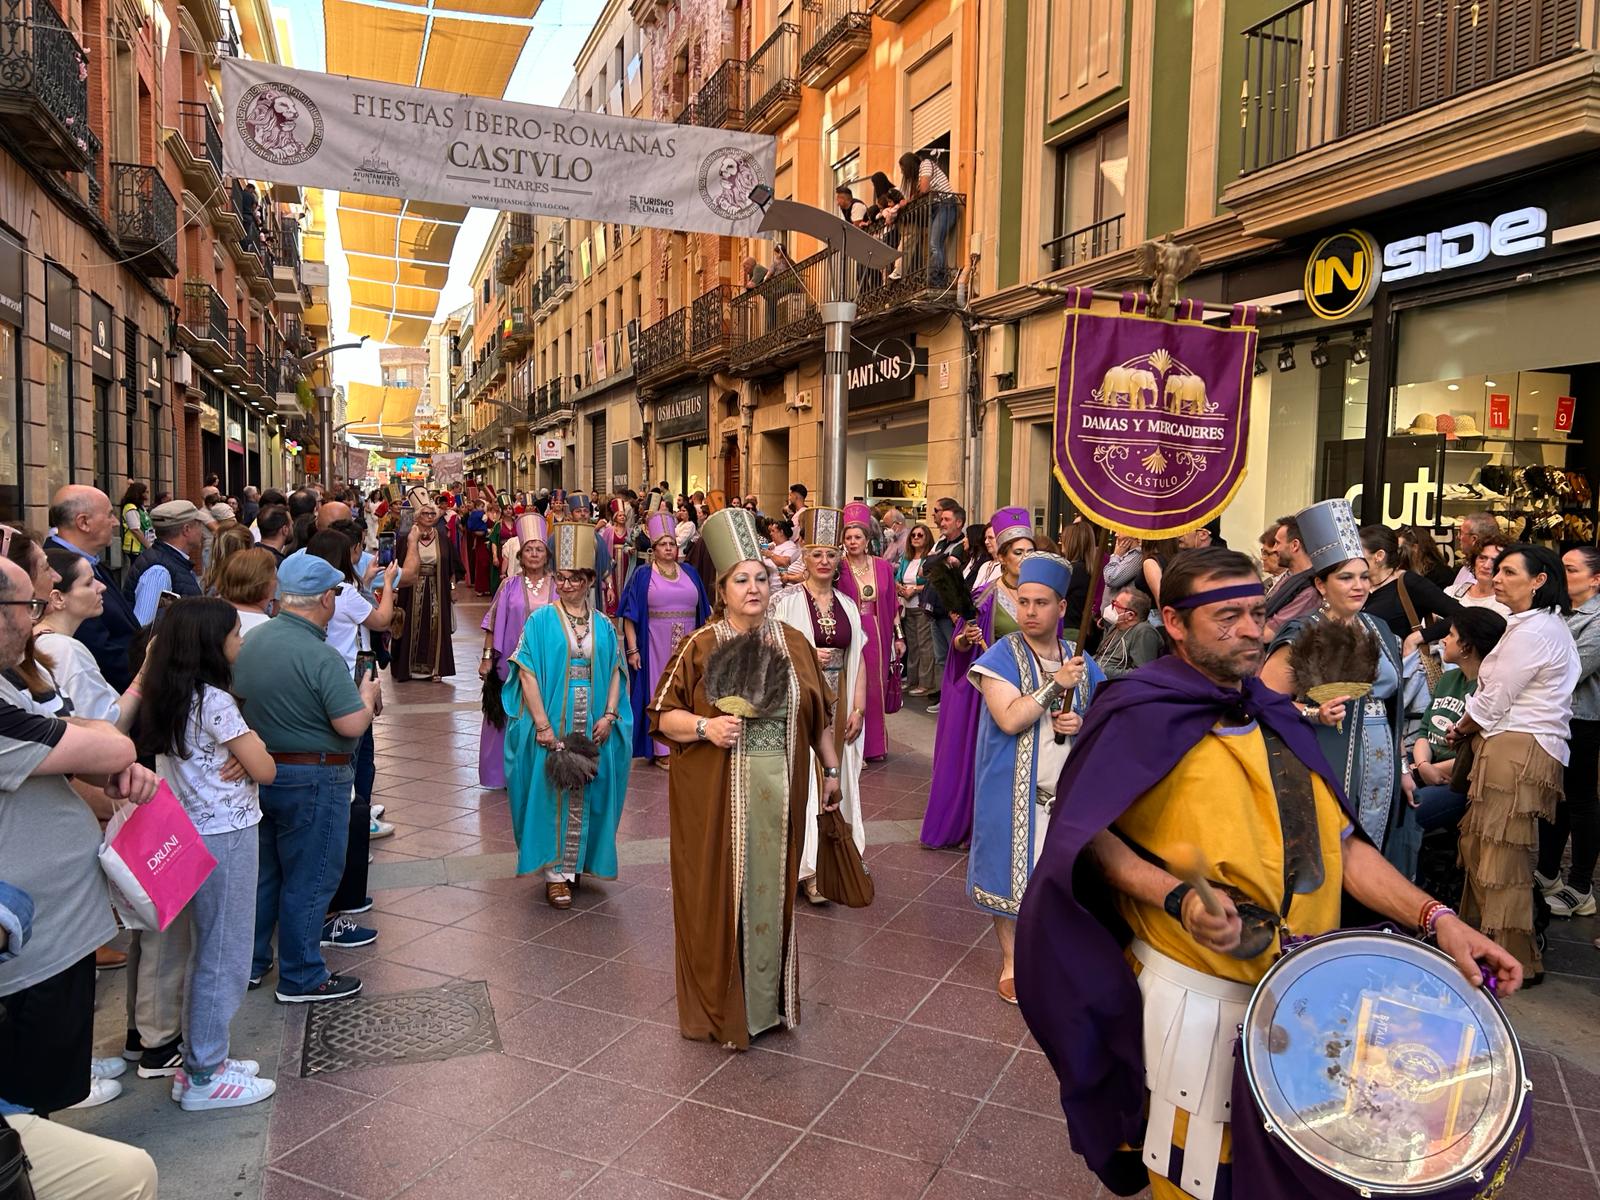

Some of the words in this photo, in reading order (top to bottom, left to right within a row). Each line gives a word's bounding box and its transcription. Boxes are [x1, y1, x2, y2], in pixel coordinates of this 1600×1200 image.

[352, 93, 454, 128] FIESTAS
[464, 109, 676, 159] IBERO-ROMANAS
[446, 141, 593, 182] CASTVLO
[353, 171, 400, 182] AYUNTAMIENTO
[367, 178, 400, 187] LINARES
[493, 177, 549, 193] LINARES
[639, 196, 674, 207] TURISMO
[642, 205, 674, 216] LINARES
[657, 395, 702, 422] OSMANTHUS
[1492, 411, 1503, 425] 11
[1558, 413, 1567, 426] 9
[1082, 415, 1128, 431] DAMAS
[1132, 419, 1144, 432] Y
[1147, 419, 1225, 441] MERCADERES
[1125, 472, 1178, 489] CÁSTULO
[147, 834, 179, 870] DRUNI
